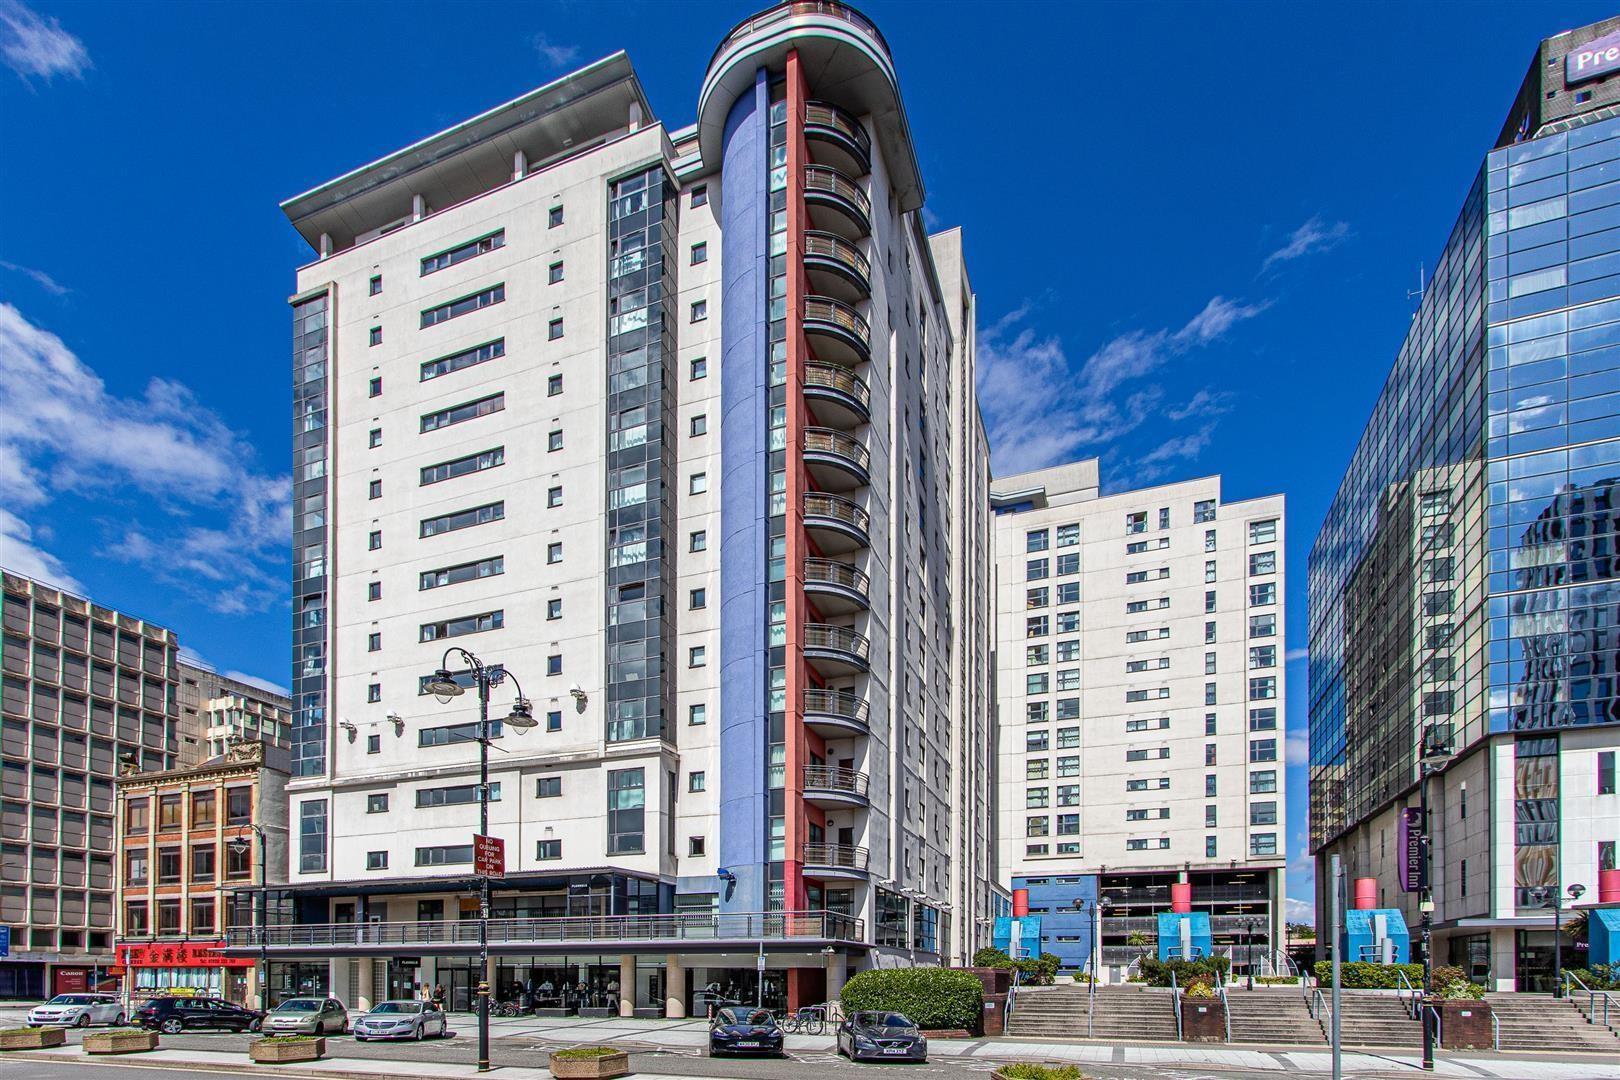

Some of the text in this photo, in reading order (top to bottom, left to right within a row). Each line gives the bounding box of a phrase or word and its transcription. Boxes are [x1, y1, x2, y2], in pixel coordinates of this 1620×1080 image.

[1577, 47, 1620, 71] Pre
[1408, 830, 1421, 888] Premier Inn
